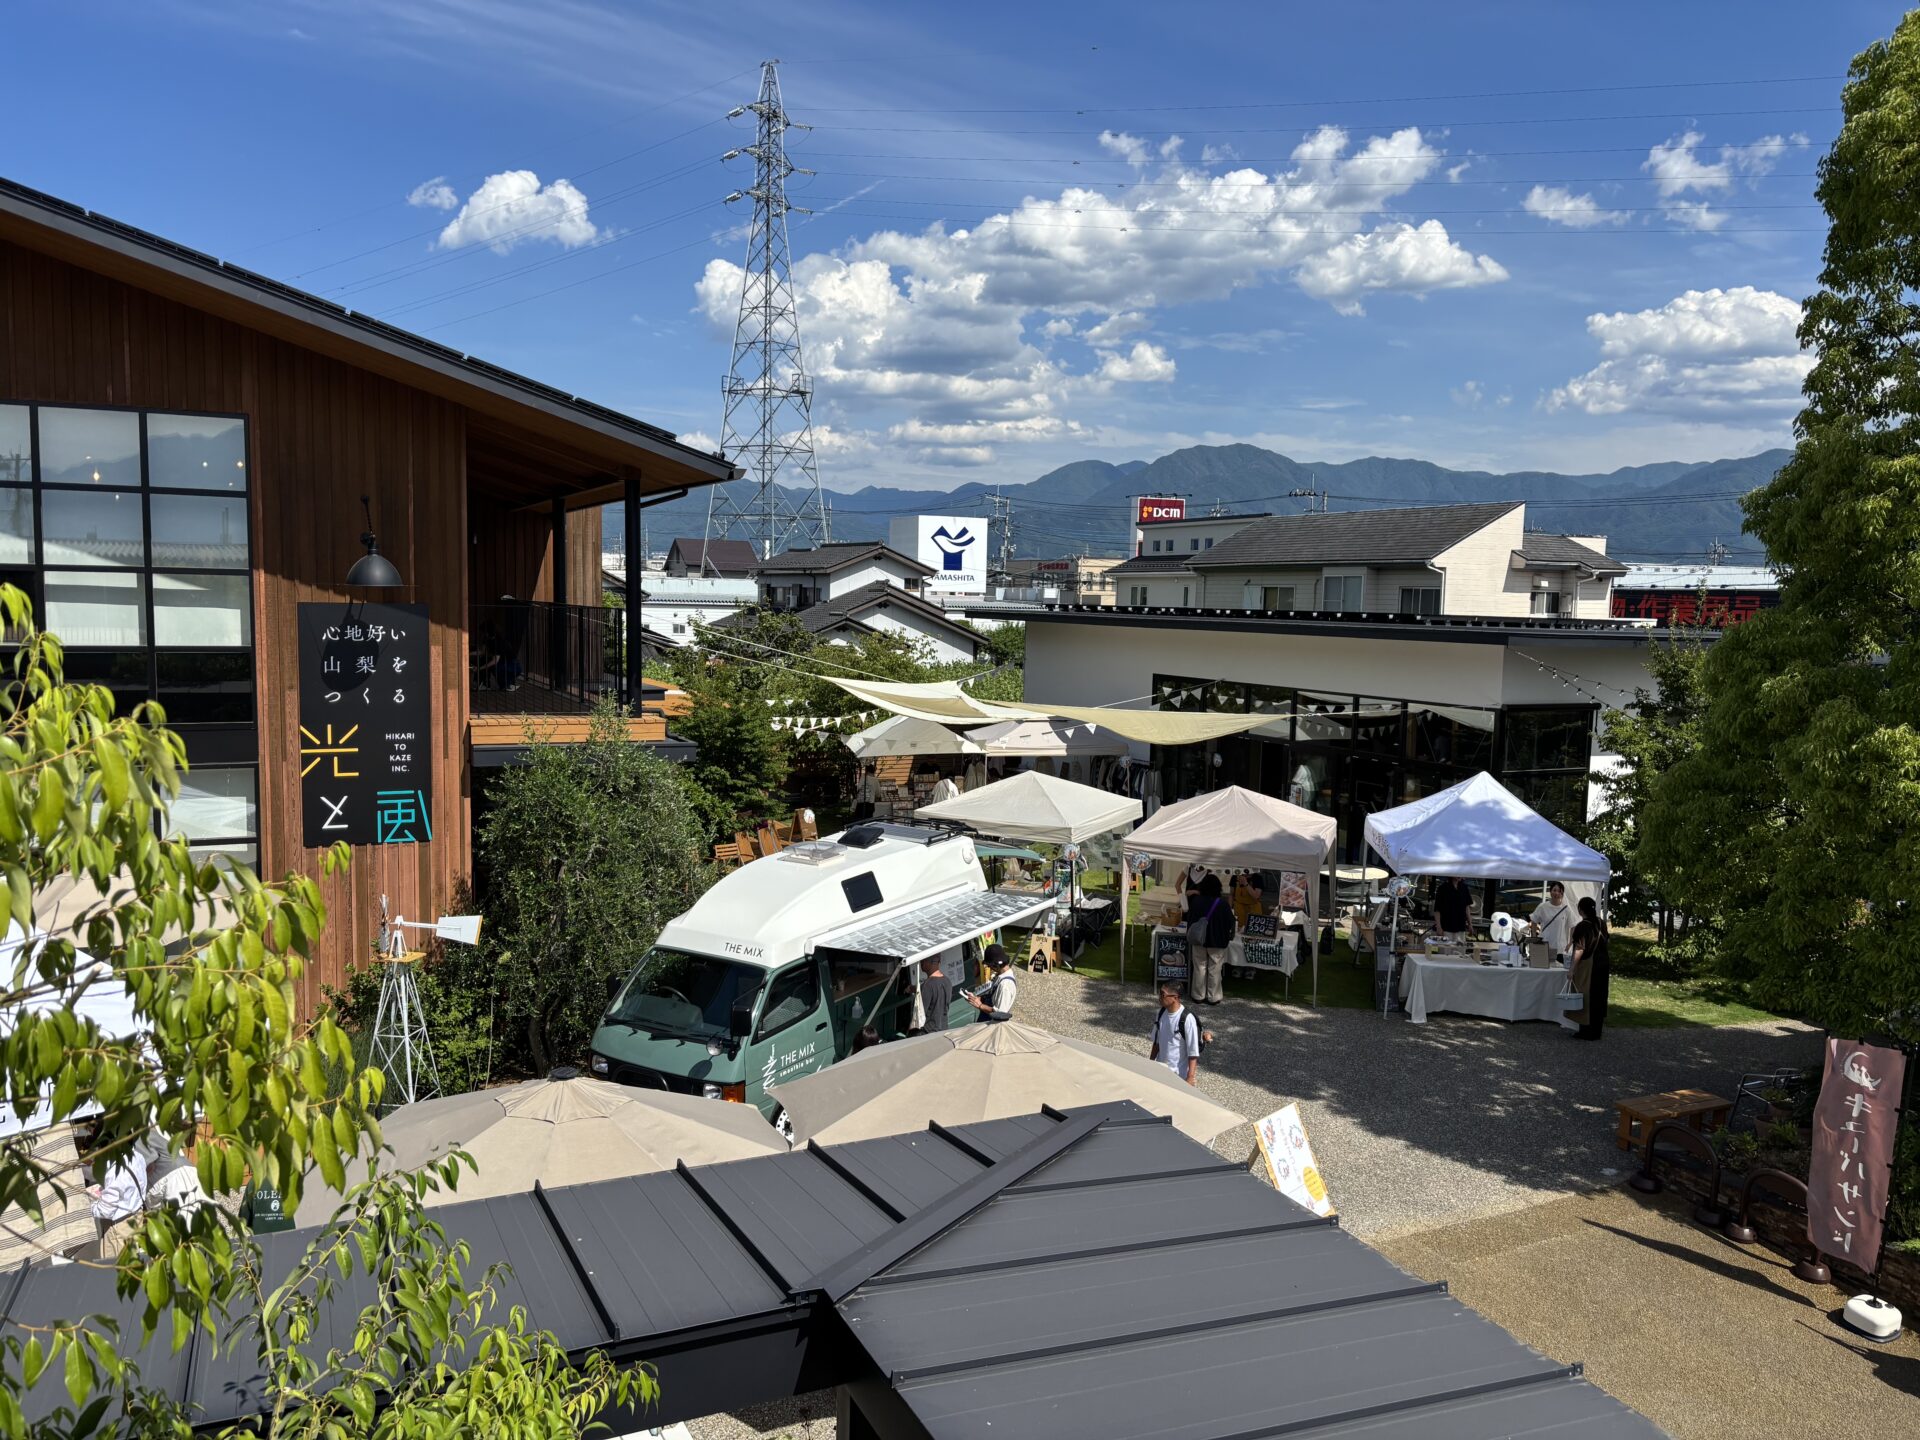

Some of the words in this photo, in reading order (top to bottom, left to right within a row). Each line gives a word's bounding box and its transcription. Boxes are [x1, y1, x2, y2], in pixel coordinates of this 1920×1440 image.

[322, 624, 406, 642] 心地好い
[323, 655, 407, 674] 山梨を
[324, 687, 406, 704] つくる
[385, 732, 415, 740] HIKARI
[394, 743, 407, 751] TO
[389, 754, 412, 762] KAZE
[725, 942, 743, 954] THE
[743, 946, 763, 957] MIX
[780, 1049, 797, 1067] THE
[798, 1041, 815, 1059] MIX
[780, 1062, 804, 1077] smoothie
